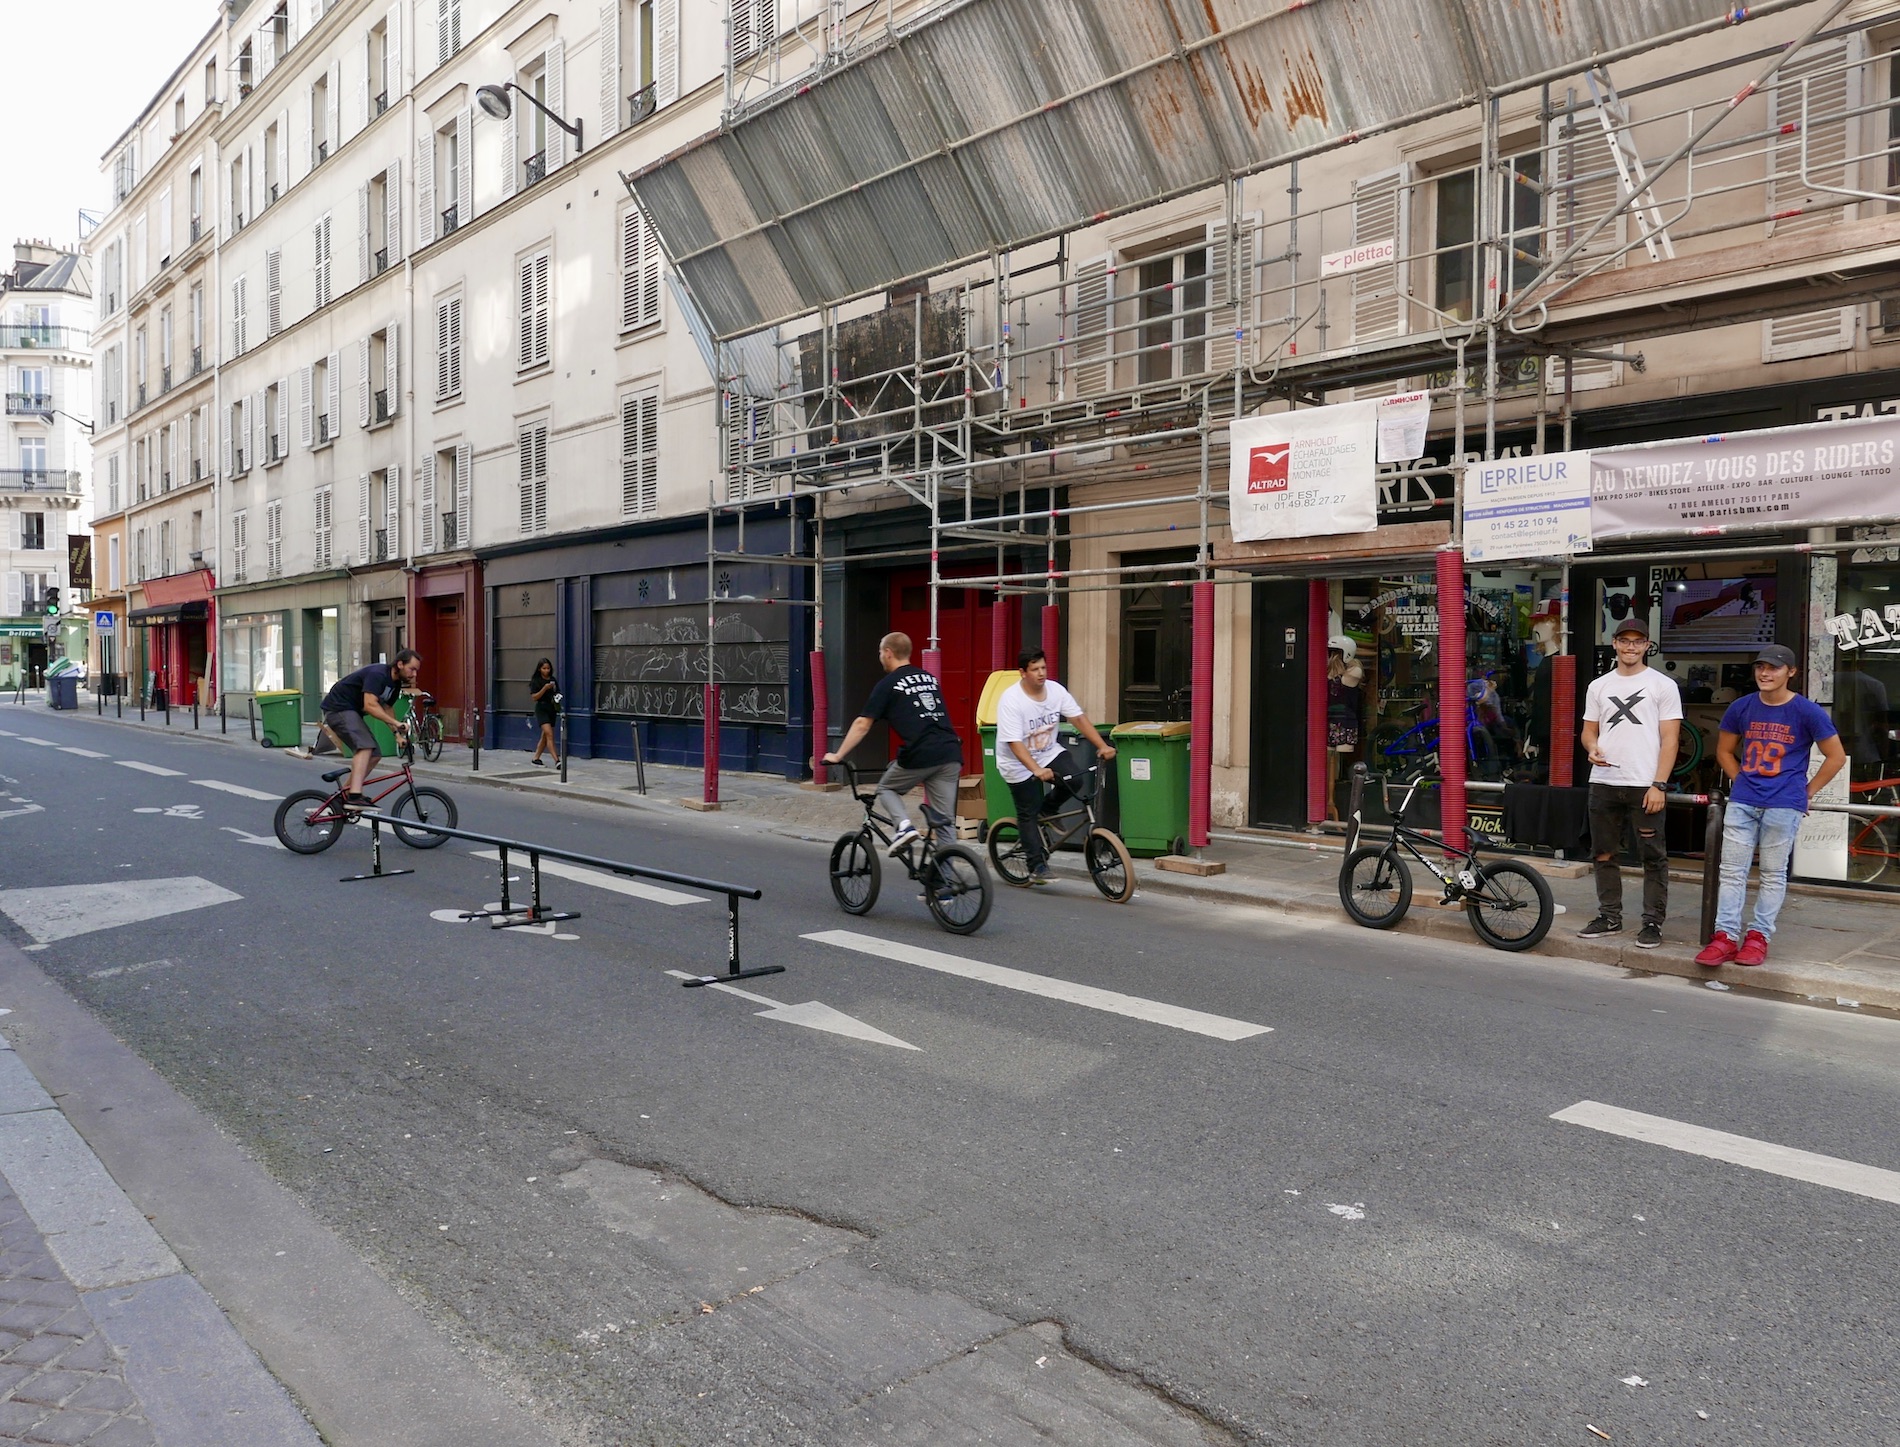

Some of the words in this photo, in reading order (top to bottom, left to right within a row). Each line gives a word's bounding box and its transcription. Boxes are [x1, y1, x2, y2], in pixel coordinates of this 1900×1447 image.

[1344, 245, 1393, 269] plettac
[1382, 394, 1423, 406] ARNHOLDT
[1294, 435, 1338, 450] ARNHOLDT
[1293, 443, 1357, 461] ÉCHAFAUDAGES
[1292, 457, 1332, 470] LOCATION
[1592, 469, 1616, 493] AU
[1765, 449, 1805, 477] DES
[1814, 439, 1894, 472] RIDERS
[1291, 468, 1331, 480] MONTAGE
[1480, 461, 1568, 494] LEPRIEUR
[1249, 478, 1286, 491] ALTRAD
[1610, 493, 1623, 501] PRO
[1625, 491, 1643, 500] SHOP
[1649, 488, 1668, 497] BIKES
[1670, 487, 1690, 496] STORE
[1697, 483, 1725, 492] ATELIER
[1732, 480, 1751, 489] EXPO
[1758, 479, 1773, 487] BAR
[1780, 475, 1813, 485] CULTURE
[1821, 470, 1853, 481] LOUNGE
[1860, 467, 1891, 477] TATTOO
[1274, 494, 1346, 509] 01.49.82.27.27
[1277, 491, 1294, 501] IDF
[1297, 489, 1319, 500] EST
[1681, 500, 1698, 509] RUE
[1701, 497, 1736, 508] AMELOT
[1740, 494, 1768, 504] 75011
[1771, 491, 1801, 501] PARIS
[1681, 503, 1790, 519] www.parisbmx.com
[1490, 522, 1501, 531] 01
[1504, 520, 1515, 529] 45
[1518, 519, 1529, 528] 22
[1532, 518, 1544, 527] 10
[1546, 516, 1559, 525] 94
[1573, 541, 1588, 549] FFB
[1652, 567, 1688, 580] BMX
[1385, 606, 1411, 615] BMX
[1414, 605, 1436, 614] PRO
[1396, 615, 1421, 624] CITY
[1742, 740, 1786, 777] 09
[1470, 815, 1505, 834] Dick
